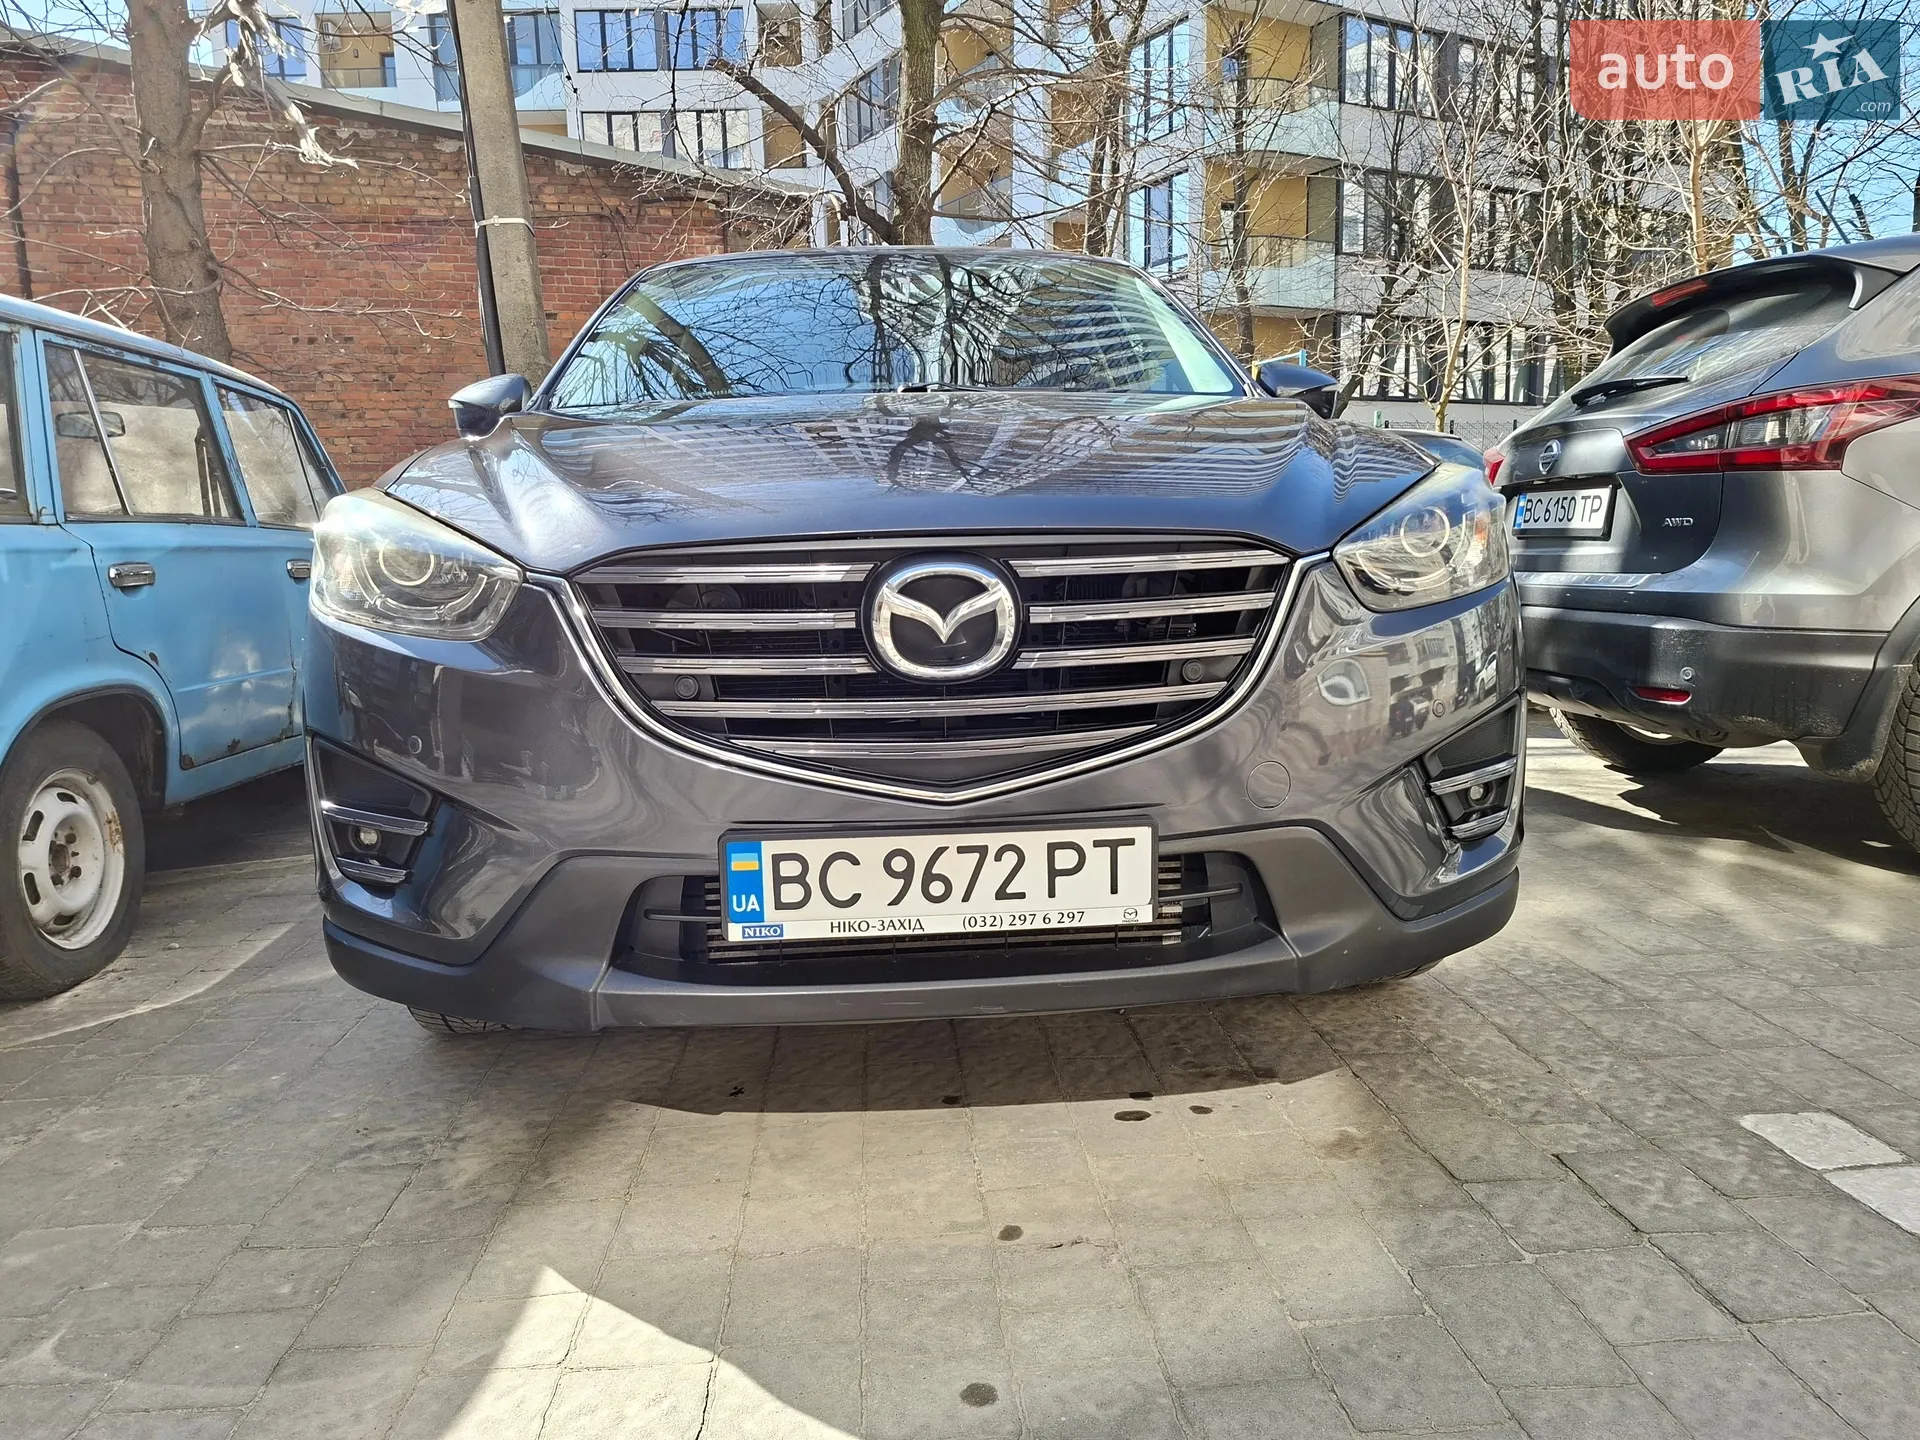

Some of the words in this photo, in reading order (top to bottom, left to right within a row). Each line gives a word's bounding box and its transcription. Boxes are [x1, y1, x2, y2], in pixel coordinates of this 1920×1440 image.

[1523, 498, 1543, 524] BC
[1544, 496, 1577, 523] 6150
[1580, 495, 1603, 523] TP
[1662, 517, 1694, 527] AWD
[771, 850, 862, 911] BC
[882, 844, 1026, 907] 9672
[1046, 837, 1136, 899] PT
[732, 894, 760, 912] UA
[830, 918, 925, 934] НІКО-ЗАХІД
[962, 914, 1004, 931] (032)
[1008, 913, 1037, 926] 297
[1042, 912, 1052, 925] 6
[1056, 911, 1086, 924] 297
[743, 926, 781, 937] NIKO
